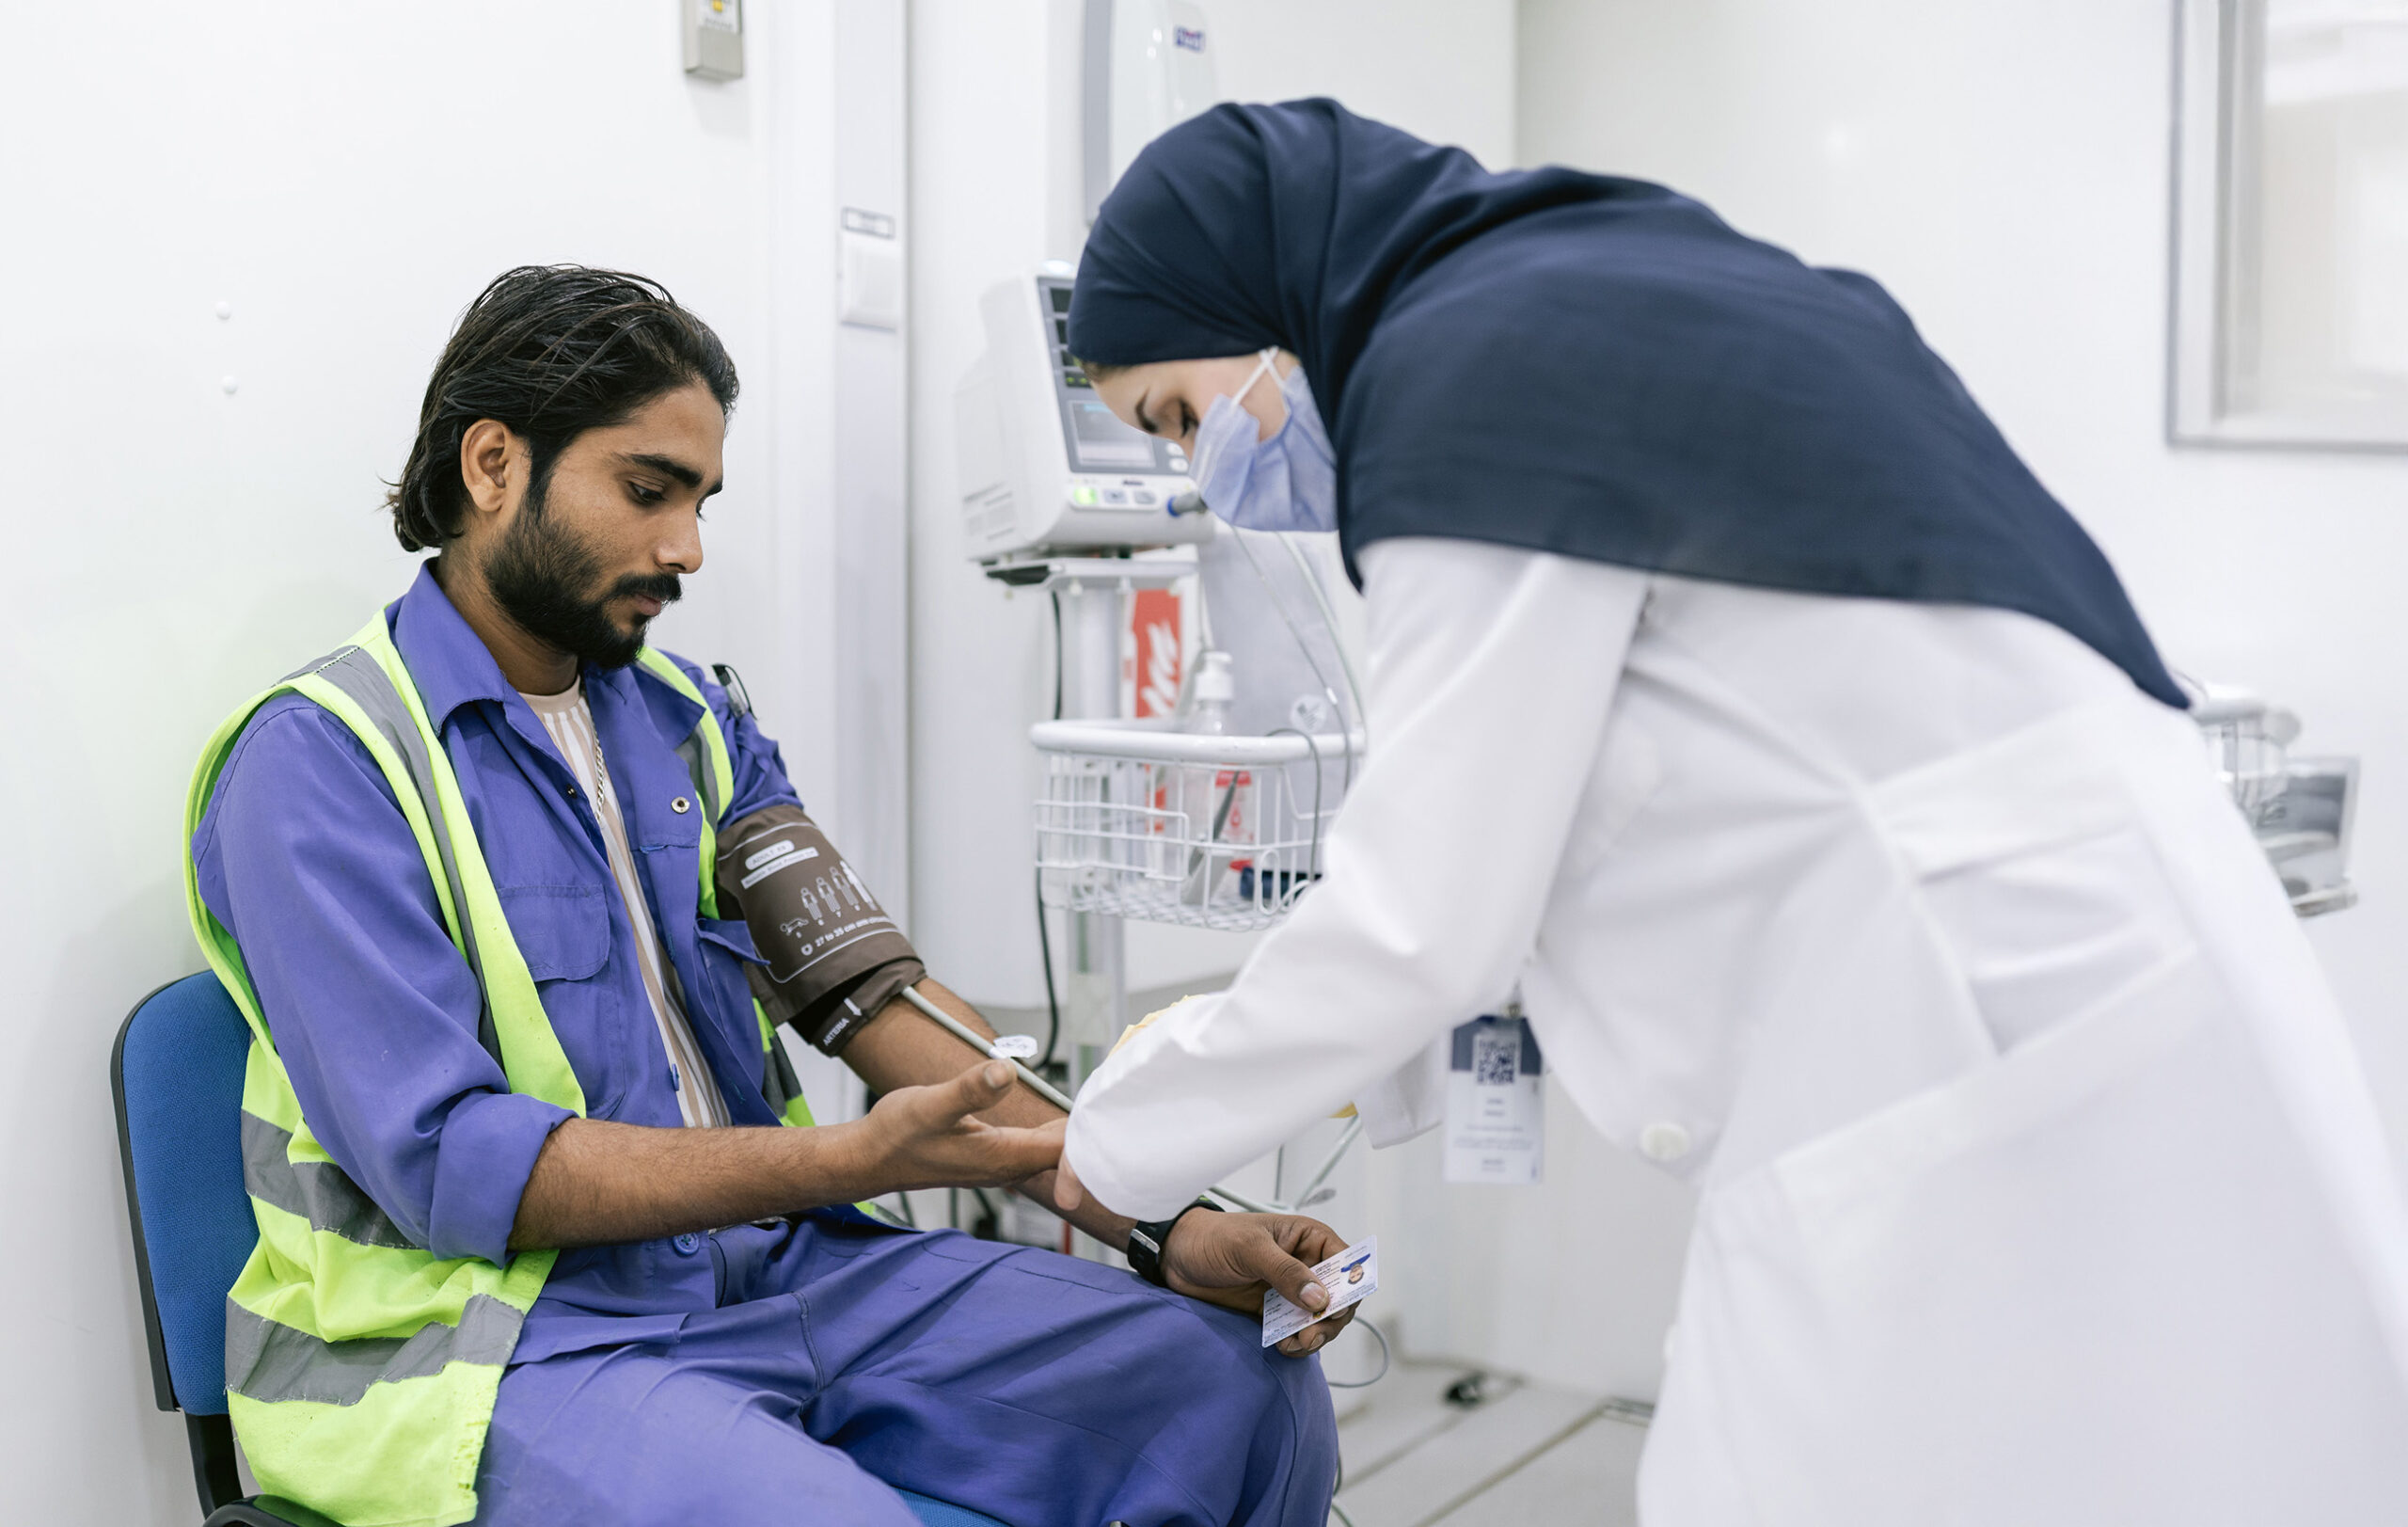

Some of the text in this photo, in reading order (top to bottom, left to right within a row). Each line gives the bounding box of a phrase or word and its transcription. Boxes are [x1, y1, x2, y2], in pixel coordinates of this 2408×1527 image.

[825, 932, 834, 941] to
[844, 923, 856, 933] cm
[823, 1017, 850, 1045] ARTERIA
